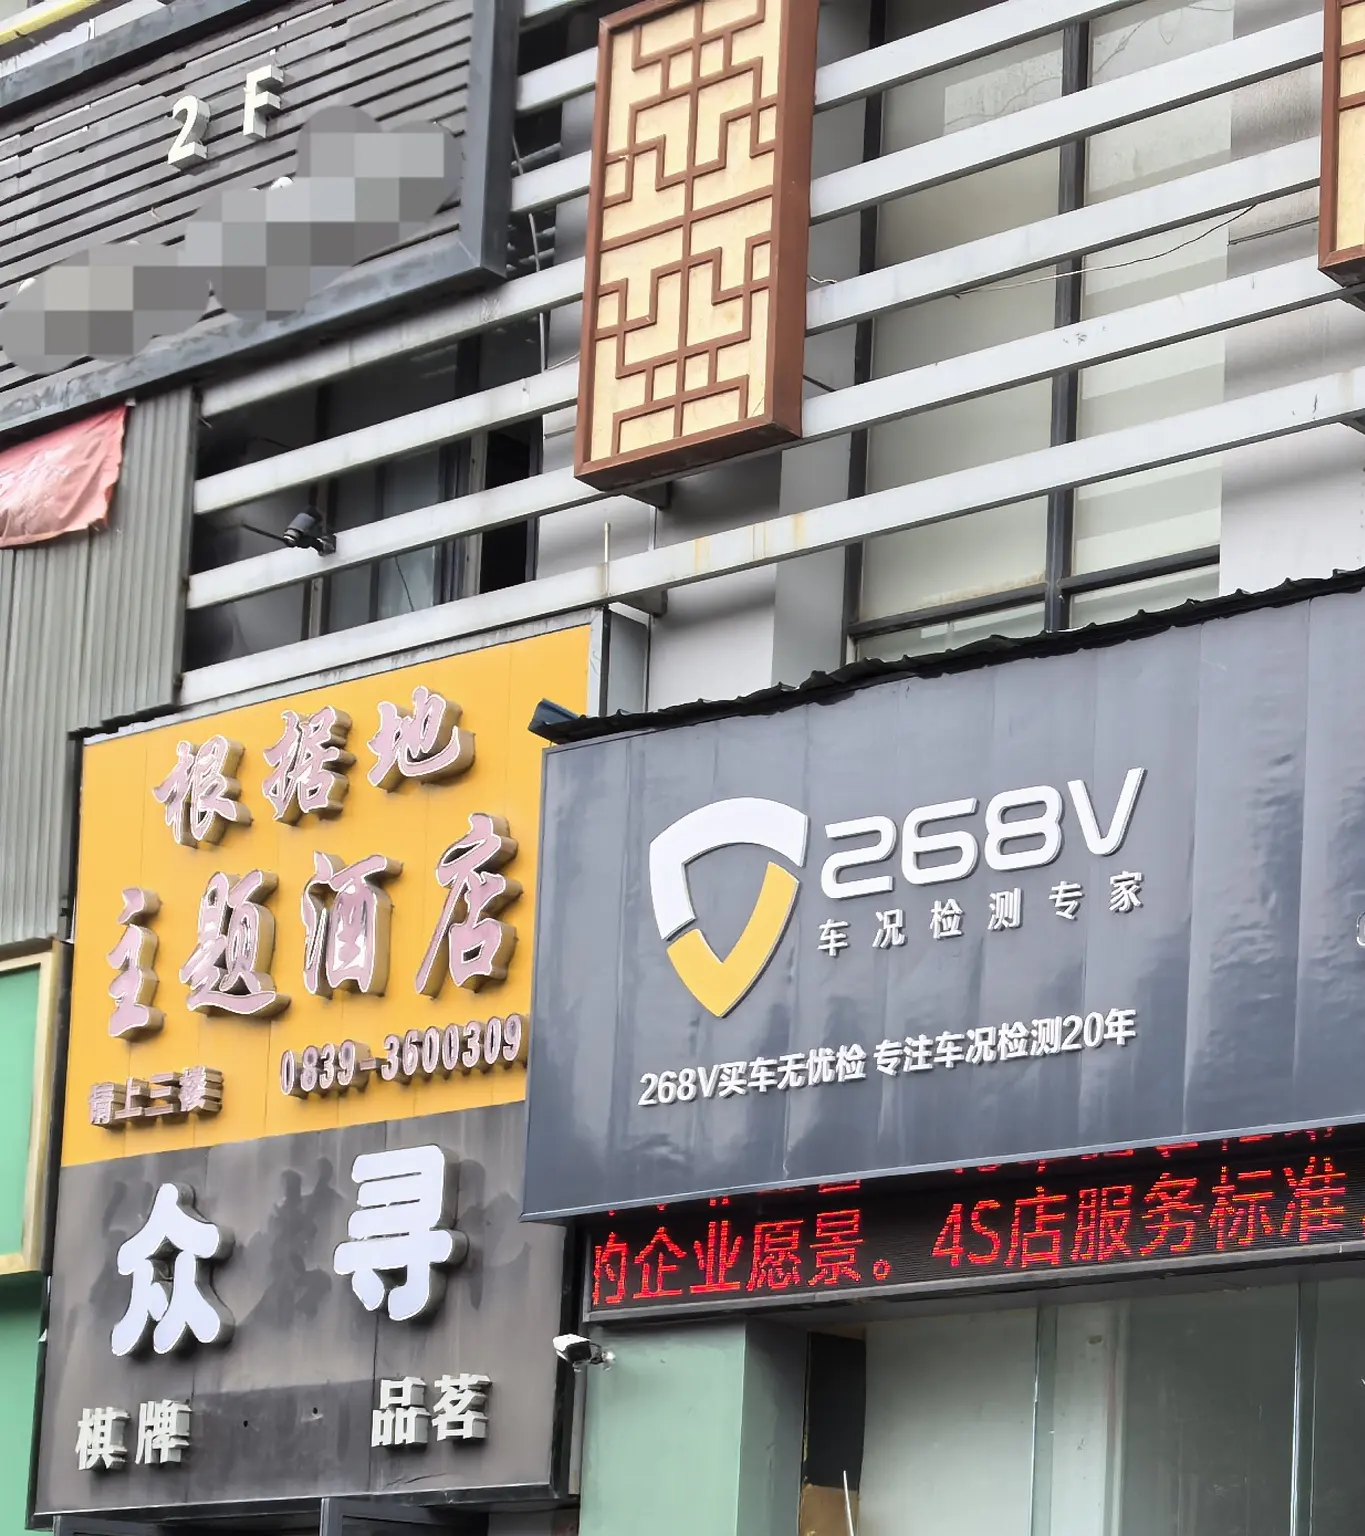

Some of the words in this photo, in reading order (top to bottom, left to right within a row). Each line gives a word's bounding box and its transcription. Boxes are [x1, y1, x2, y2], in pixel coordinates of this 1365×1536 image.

[154, 686, 472, 848] 根据地
[820, 766, 1147, 900] 268V
[108, 813, 522, 1040] 主题酒店
[818, 871, 1144, 956] 车况检测专家
[280, 1012, 528, 1097] 0839-3600309
[637, 1045, 867, 1106] 268V买车无忧检
[873, 1007, 1138, 1076] 专注车况检测20年
[75, 1399, 193, 1471] 棋牌
[371, 1373, 492, 1448] 品茗
